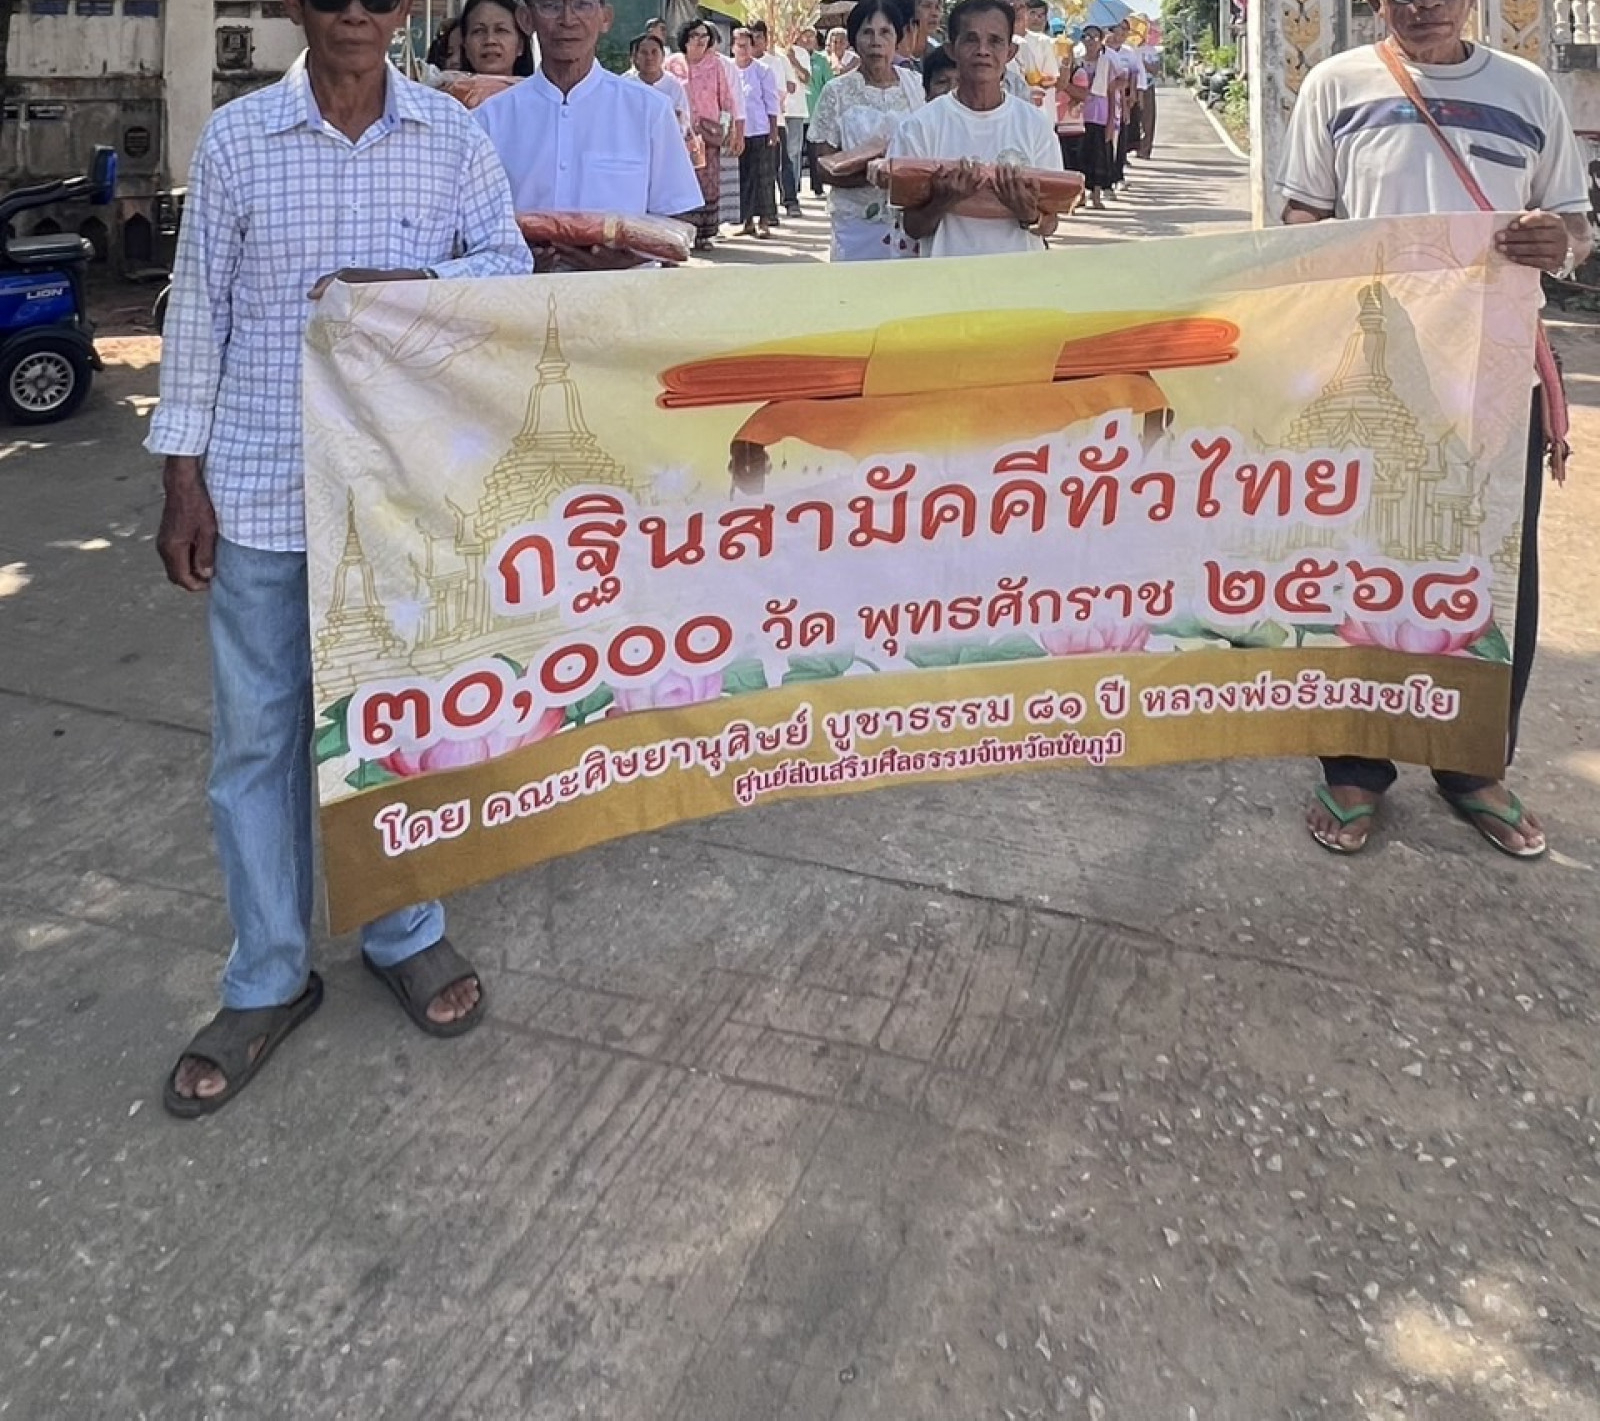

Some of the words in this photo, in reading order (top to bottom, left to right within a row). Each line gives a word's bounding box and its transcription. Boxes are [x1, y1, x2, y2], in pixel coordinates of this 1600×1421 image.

[26, 287, 63, 300] LION
[498, 419, 1361, 614] กฐินสามัคคีทั่วไทย
[362, 614, 733, 746] ๓๐,๐๐๐
[761, 598, 836, 651] วัด
[857, 576, 1175, 657] พุทธศักราช
[1203, 557, 1481, 622] ๒๕๖๘
[380, 809, 466, 851] โดย
[486, 710, 809, 824] คณะศิษยานุศิษย์
[825, 698, 1010, 751] บูชาธรรม
[1028, 695, 1083, 720] ๘๑
[1100, 679, 1127, 716] ปี
[1144, 673, 1454, 717] หลวงพ่อธัมมชโย
